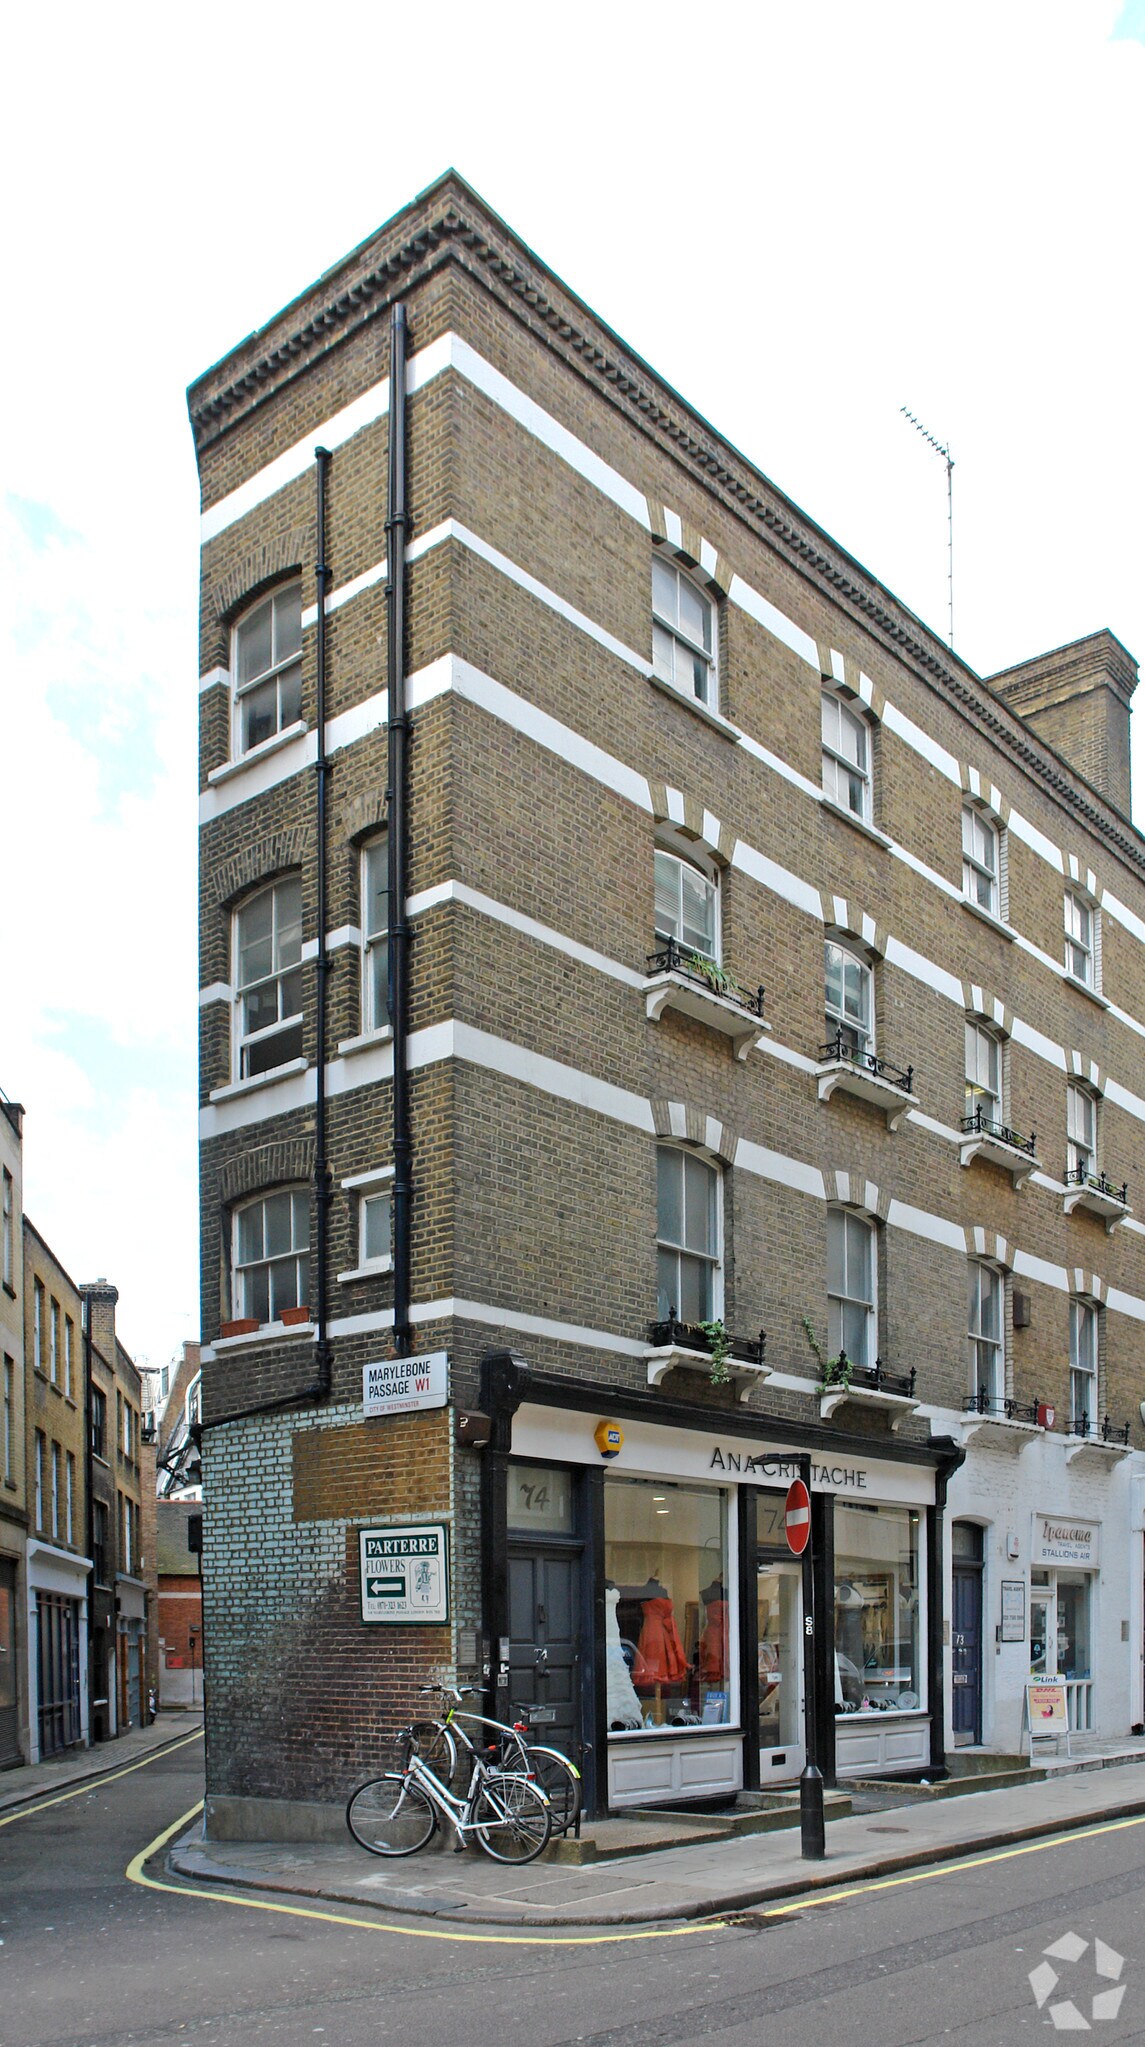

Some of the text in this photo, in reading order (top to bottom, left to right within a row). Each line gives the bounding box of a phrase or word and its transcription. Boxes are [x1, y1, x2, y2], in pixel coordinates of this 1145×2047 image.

[369, 1361, 431, 1382] MARYLEBONE
[369, 1378, 430, 1399] PASSAGE W1
[387, 1401, 419, 1411] WESTMINSTER
[520, 1483, 550, 1513] 74
[367, 1537, 437, 1555] PARTERRE
[1057, 1541, 1073, 1549] TRAVEL
[1042, 1548, 1091, 1560] STALLIONS AIR
[366, 1559, 406, 1574] FLOWERS
[956, 1634, 965, 1645] 73
